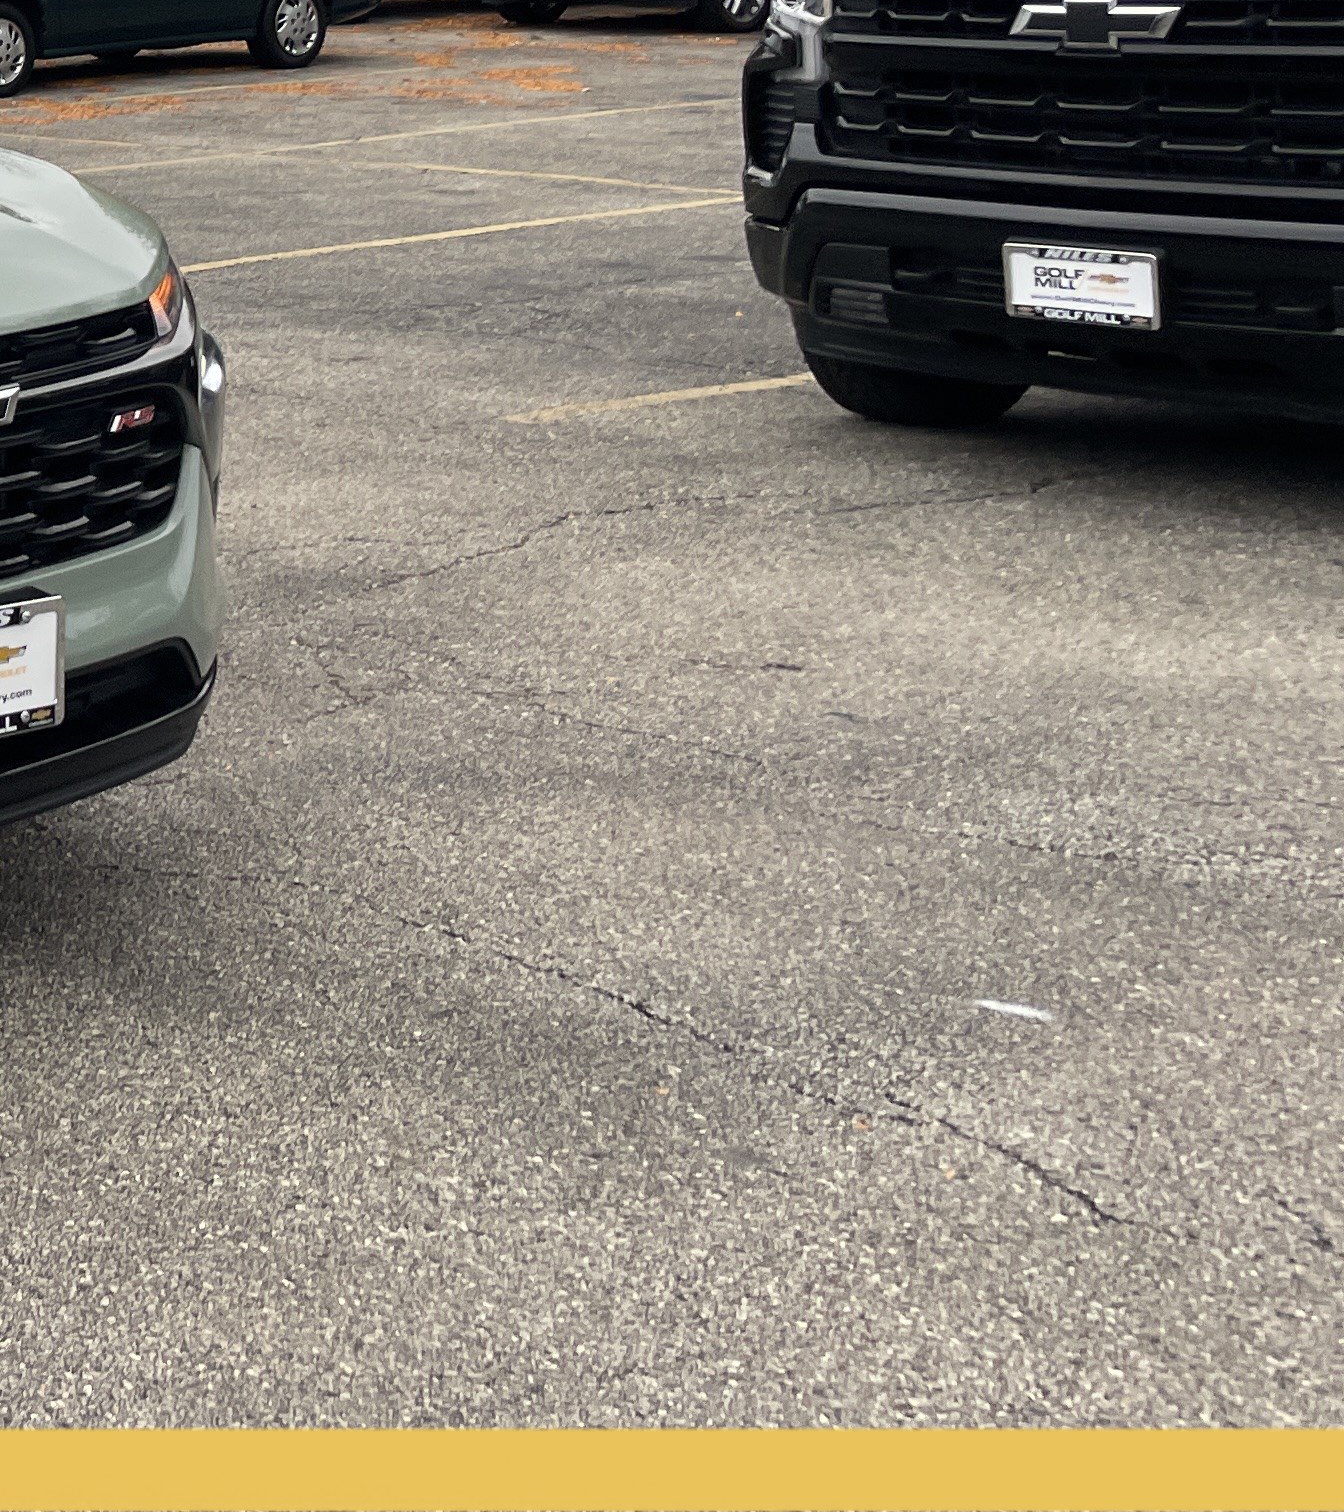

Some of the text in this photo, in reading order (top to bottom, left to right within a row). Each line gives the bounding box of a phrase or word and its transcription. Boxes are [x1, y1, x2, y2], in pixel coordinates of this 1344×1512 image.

[1034, 266, 1085, 280] GOLF
[1034, 277, 1076, 290] MILL
[1043, 308, 1121, 325] GOLF MILL
